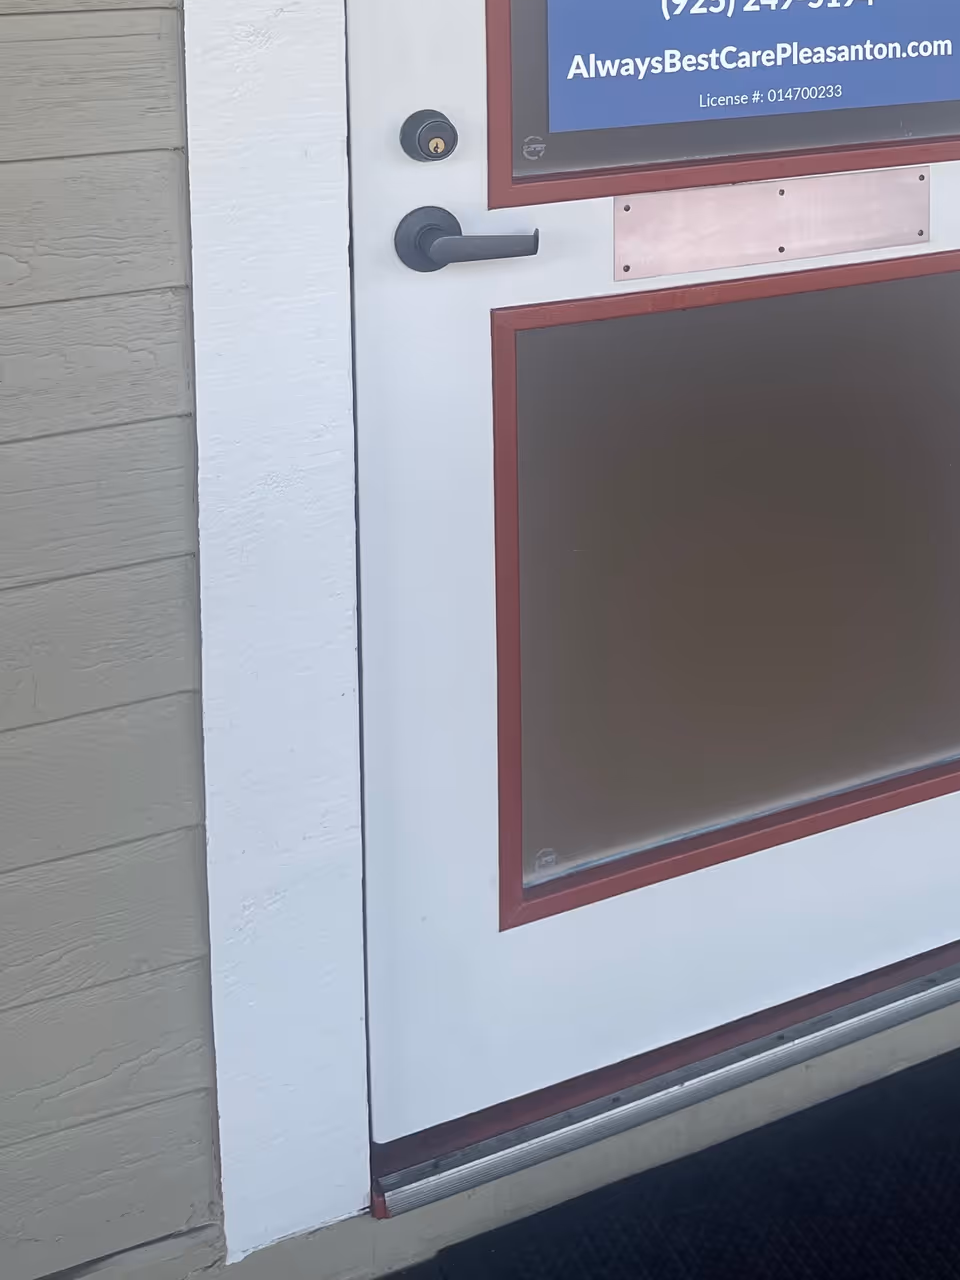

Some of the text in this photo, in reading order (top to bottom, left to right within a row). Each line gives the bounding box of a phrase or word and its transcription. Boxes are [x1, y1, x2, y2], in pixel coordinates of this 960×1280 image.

[566, 39, 952, 80] AlwaysBestCarePleasanton.com
[699, 84, 843, 108] License #: 014700233
